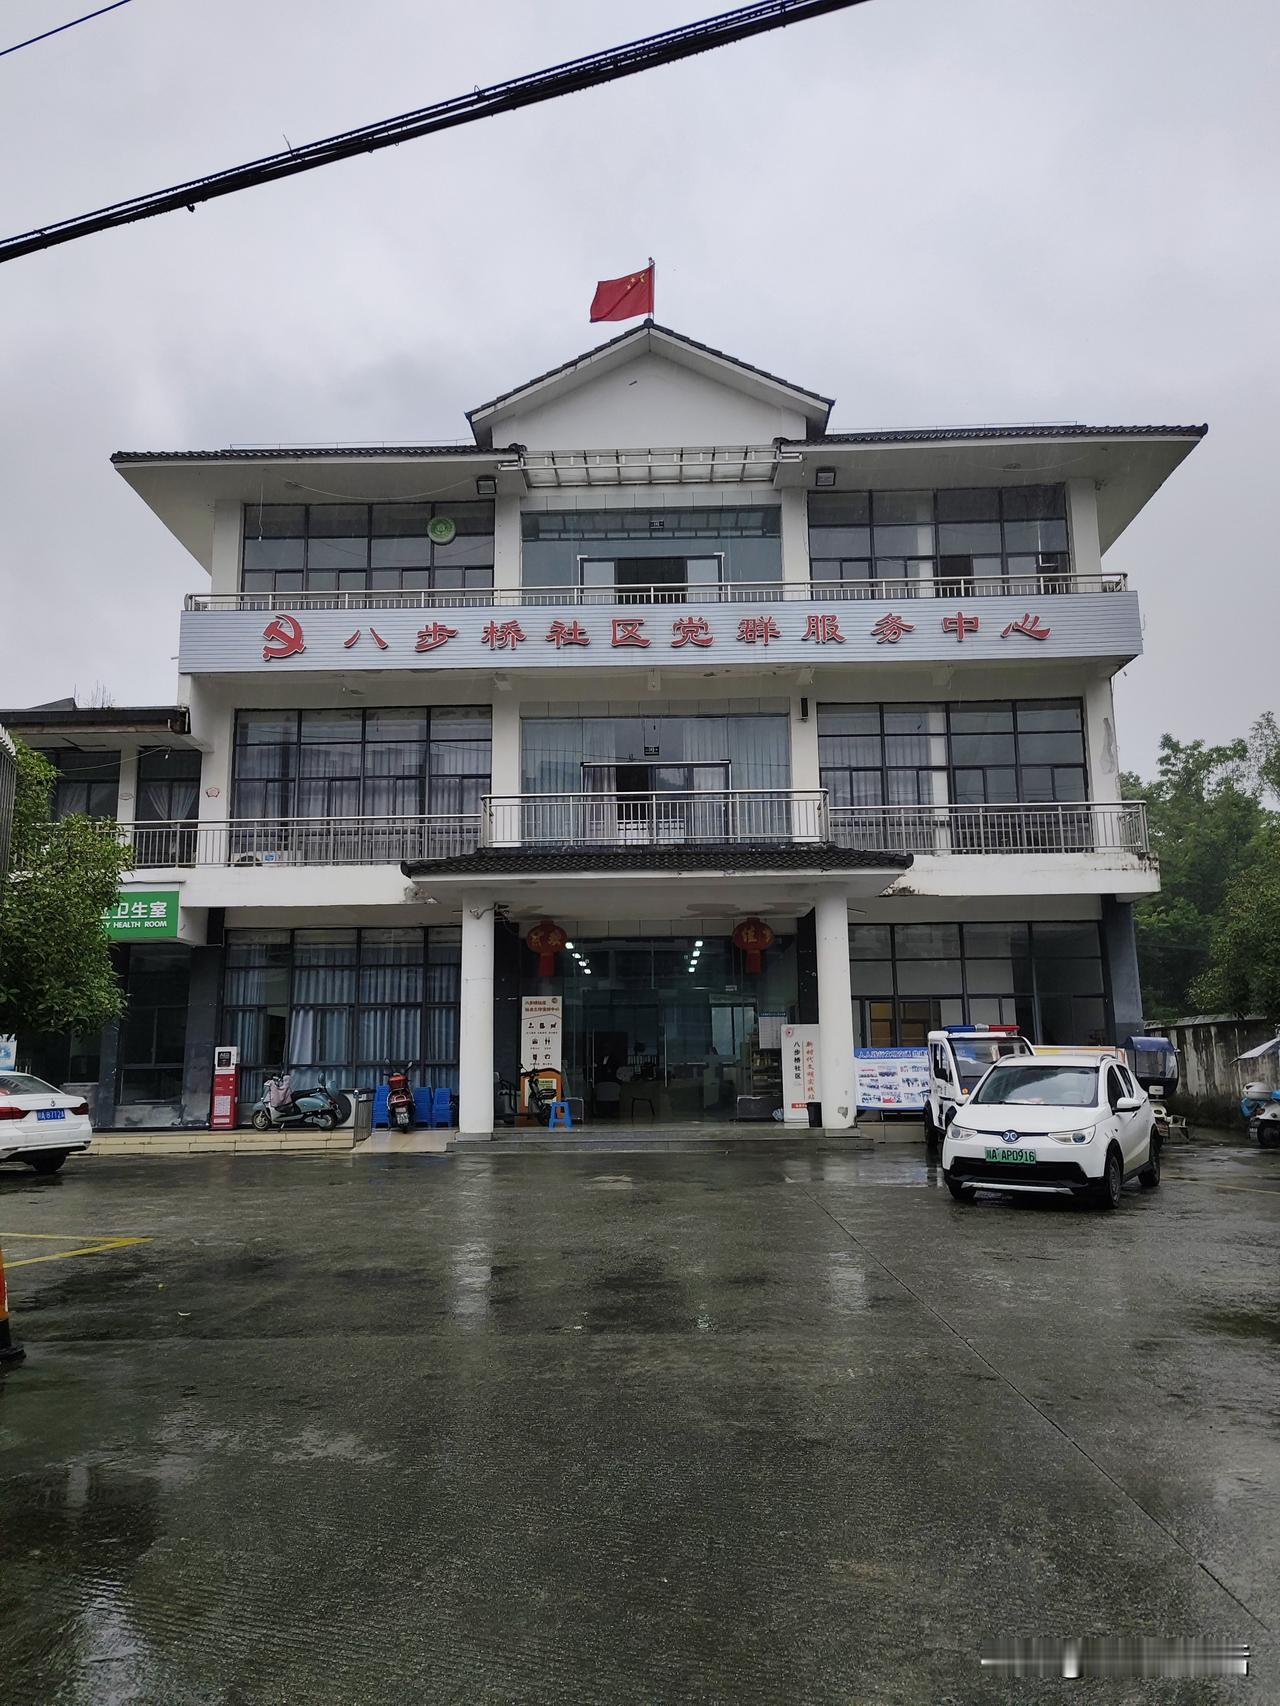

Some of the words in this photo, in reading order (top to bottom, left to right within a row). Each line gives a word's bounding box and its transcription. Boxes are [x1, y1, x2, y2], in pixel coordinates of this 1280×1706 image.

[343, 611, 1052, 653] 八步桥社区党群服务中心
[144, 920, 167, 928] ROOM
[793, 1041, 801, 1080] 八步桥社区
